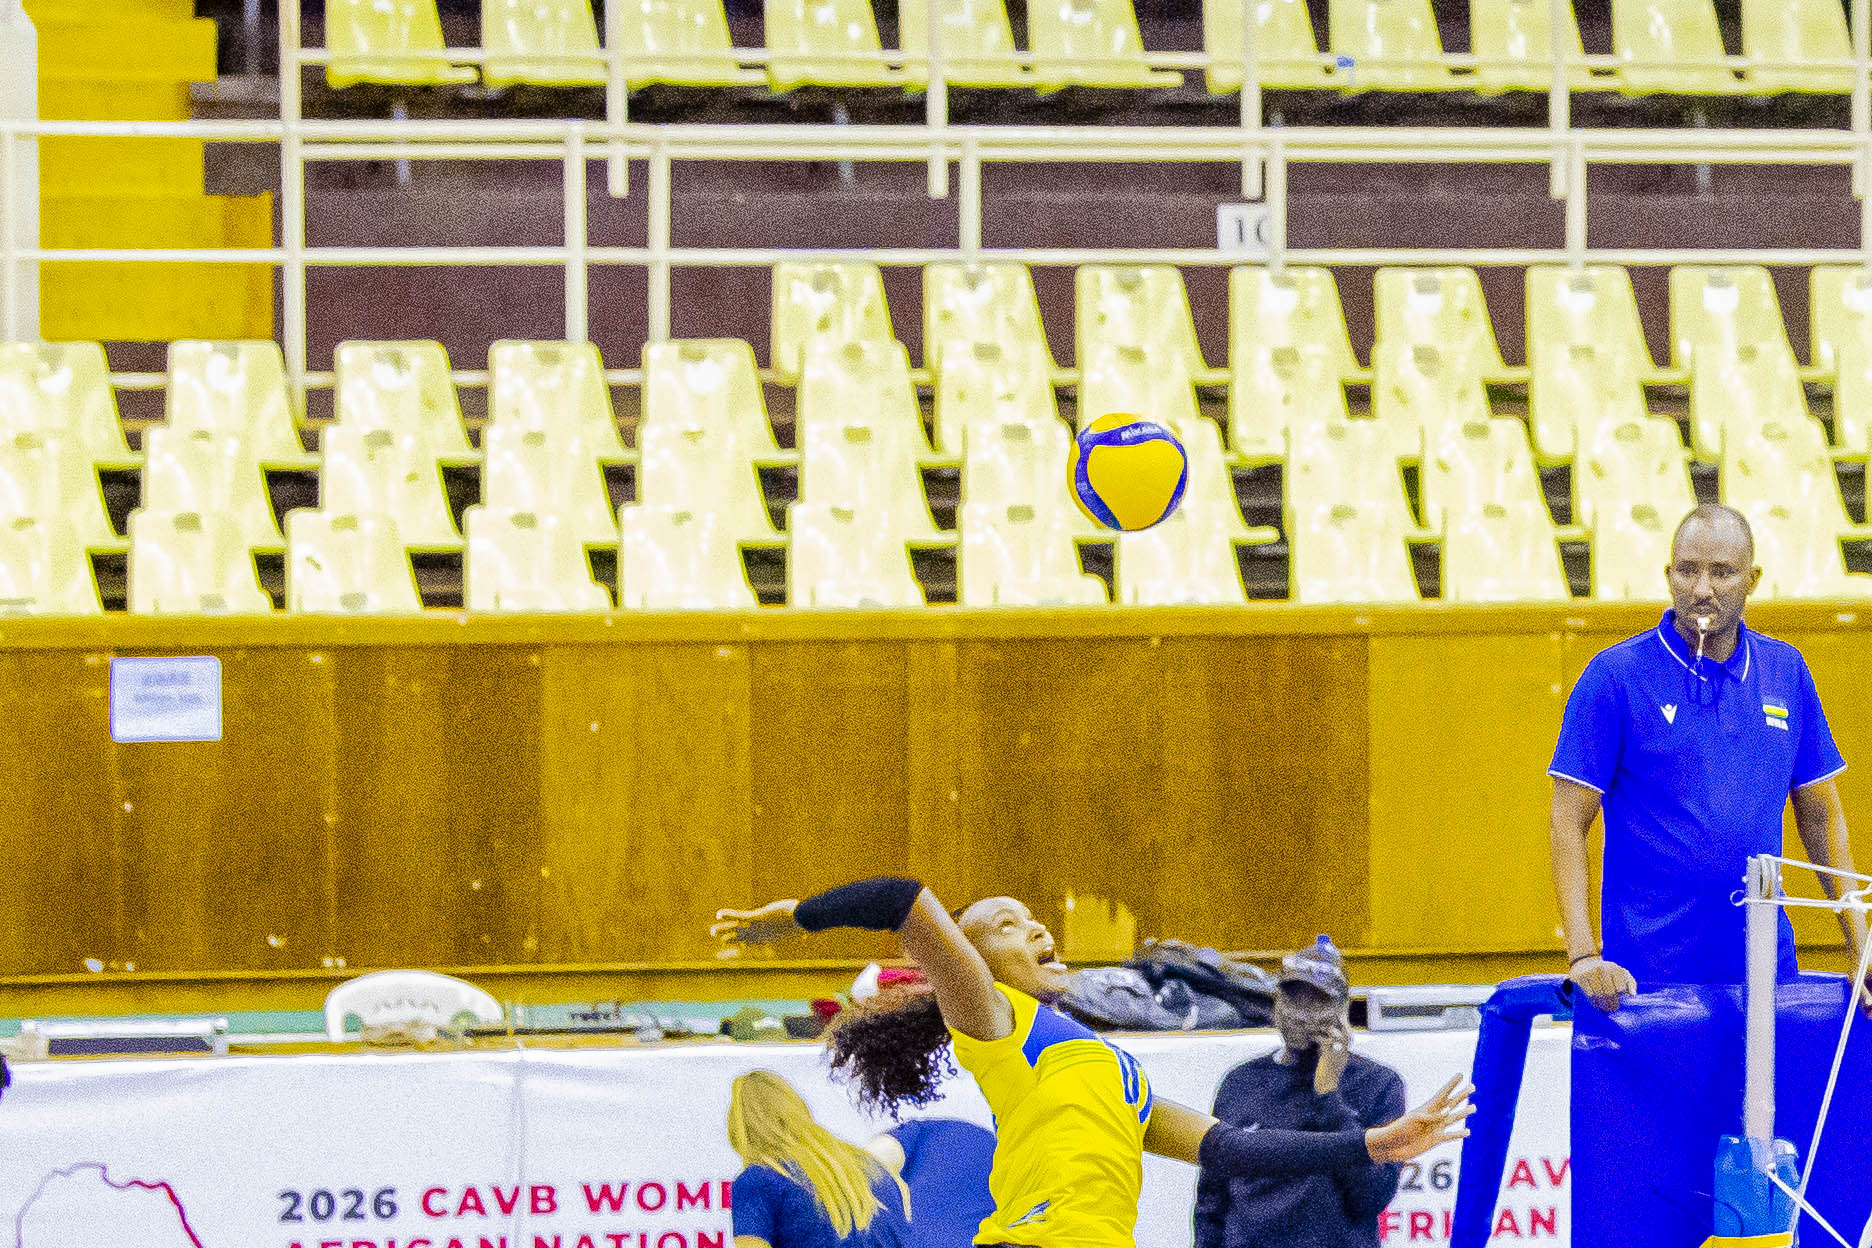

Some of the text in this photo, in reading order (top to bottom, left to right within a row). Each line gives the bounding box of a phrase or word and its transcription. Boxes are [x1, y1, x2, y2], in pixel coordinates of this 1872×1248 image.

[278, 1187, 398, 1222] 2026
[421, 1184, 557, 1217] CAVB
[1378, 1208, 1556, 1241] FRIAN
